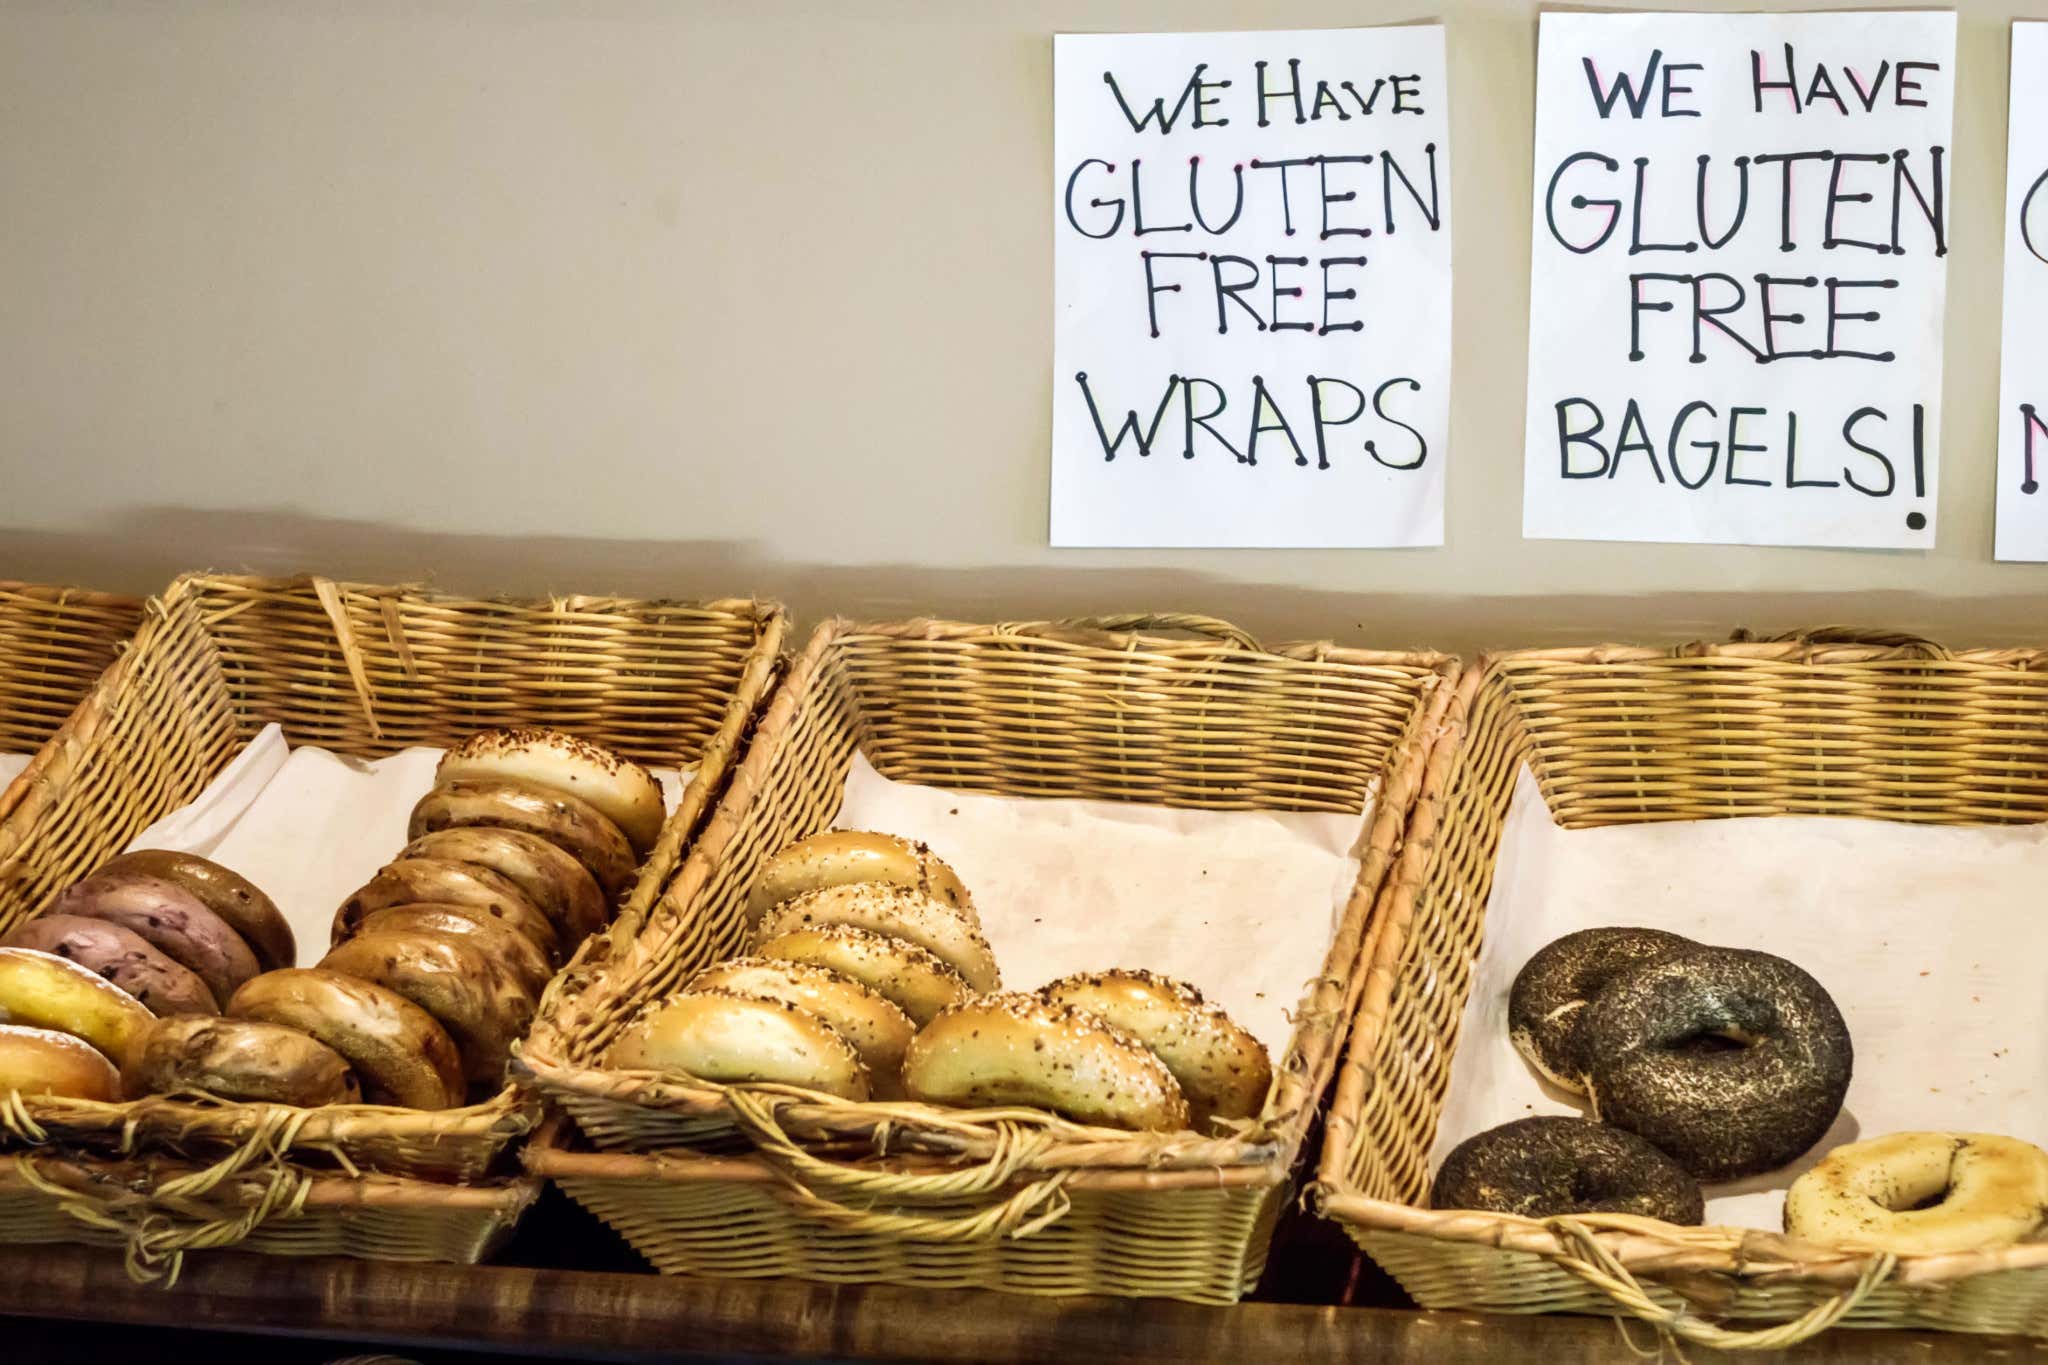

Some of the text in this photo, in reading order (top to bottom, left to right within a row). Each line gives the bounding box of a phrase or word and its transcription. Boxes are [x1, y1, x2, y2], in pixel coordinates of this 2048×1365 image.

[1103, 58, 1425, 135] WE HAVE
[1582, 42, 1940, 119] WE HAVE
[1065, 142, 1440, 241] GLUTEN
[1545, 145, 1948, 258] GLUTEN
[1140, 250, 1367, 339] FREE
[1628, 272, 1899, 365] FREE
[1075, 371, 1427, 471] WRAPS
[1554, 397, 1927, 531] BAGELS!
